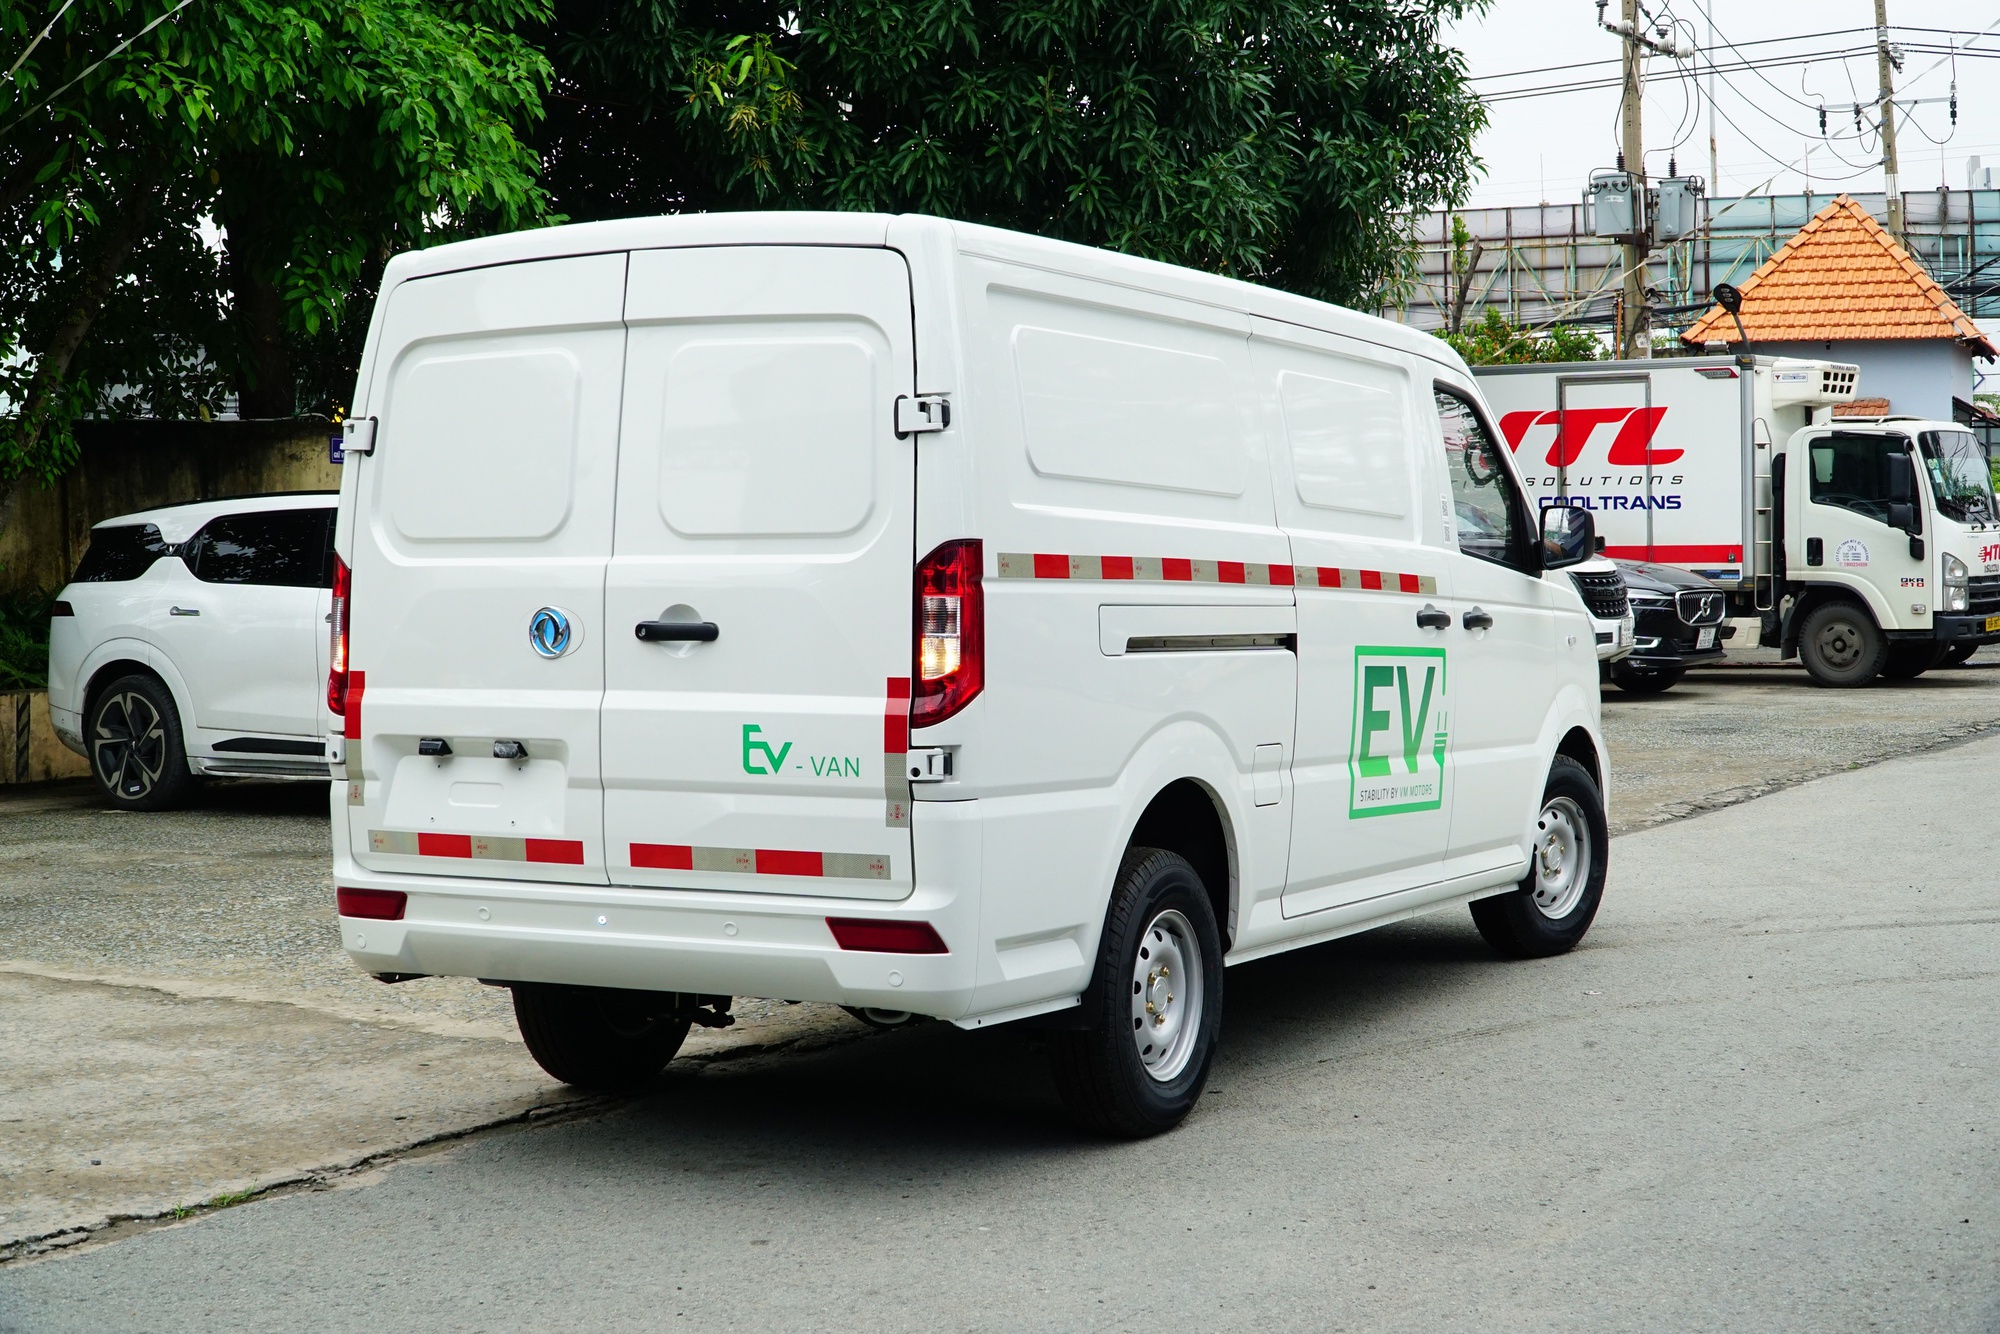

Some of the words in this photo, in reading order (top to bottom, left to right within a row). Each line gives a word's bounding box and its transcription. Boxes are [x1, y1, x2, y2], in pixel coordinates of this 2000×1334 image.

[1525, 475, 1684, 487] SOLUTIONS
[1538, 495, 1682, 510] COOLTRANS
[1983, 544, 2000, 563] HT
[1358, 665, 1436, 778] EV
[810, 756, 860, 778] VAN
[1360, 788, 1390, 802] STABILITY
[1391, 787, 1399, 799] BY
[1410, 784, 1432, 797] MOTORS
